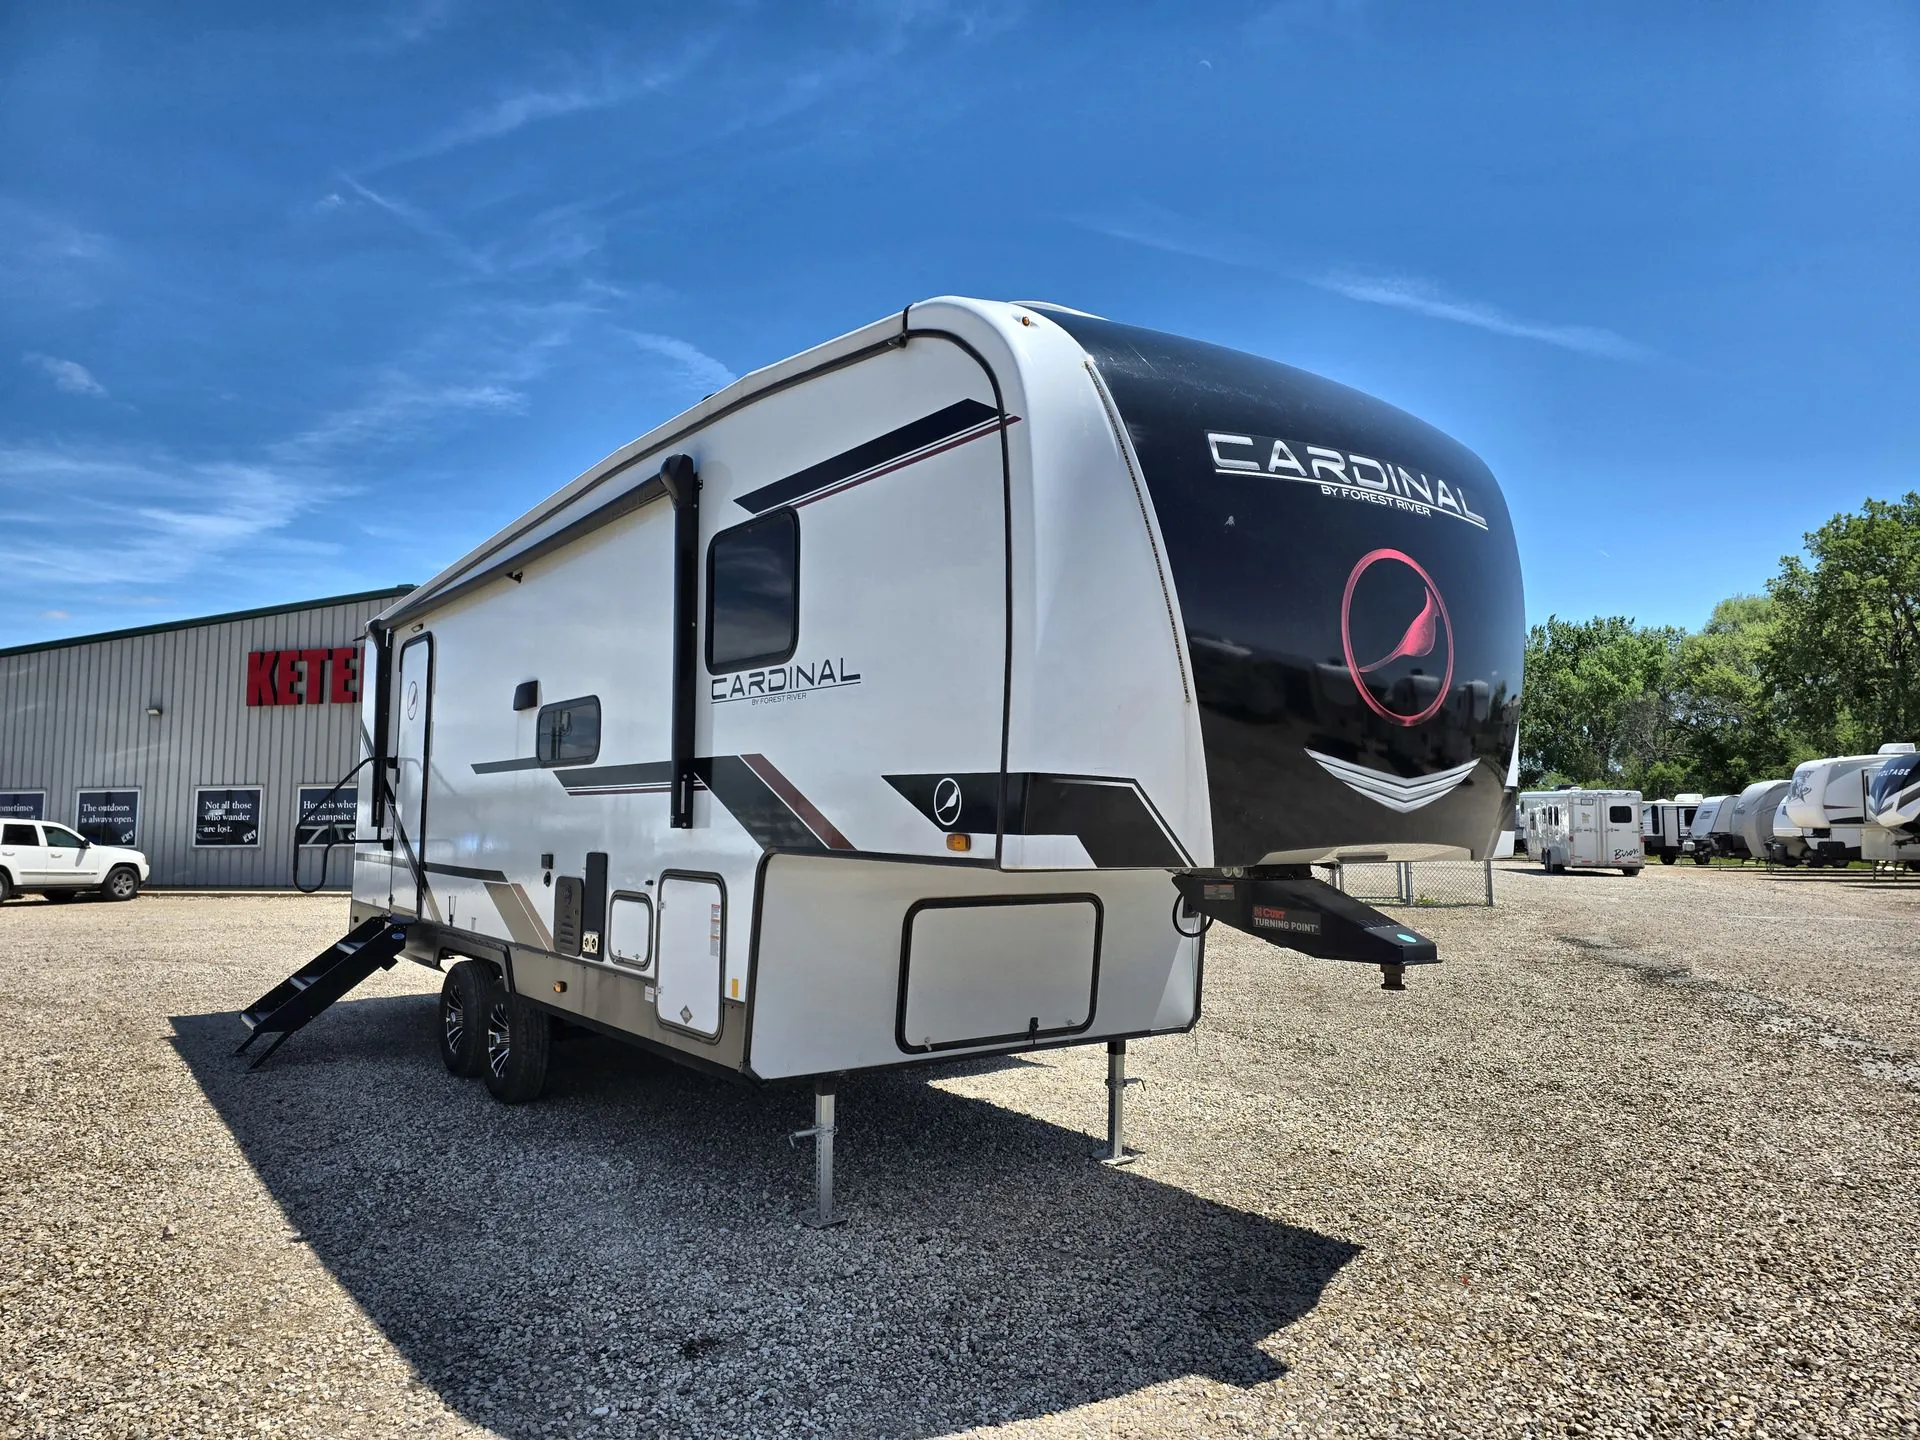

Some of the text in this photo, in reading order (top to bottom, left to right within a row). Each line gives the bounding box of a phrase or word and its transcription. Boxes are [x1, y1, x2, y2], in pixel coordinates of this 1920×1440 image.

[1207, 432, 1488, 526] CARDINAL
[1320, 485, 1432, 517] BY FOREST RIVER
[246, 647, 366, 707] KETE
[711, 657, 861, 700] CARDINAL
[751, 691, 807, 706] BY FOREST RIVER
[82, 803, 130, 812] The outdoors
[205, 801, 252, 809] Not all those
[328, 800, 335, 809] is
[336, 799, 357, 809] wher
[81, 815, 134, 824] is always open.
[204, 812, 250, 821] who wander
[317, 811, 351, 822] campsite
[1254, 917, 1316, 933] TURNING POINT
